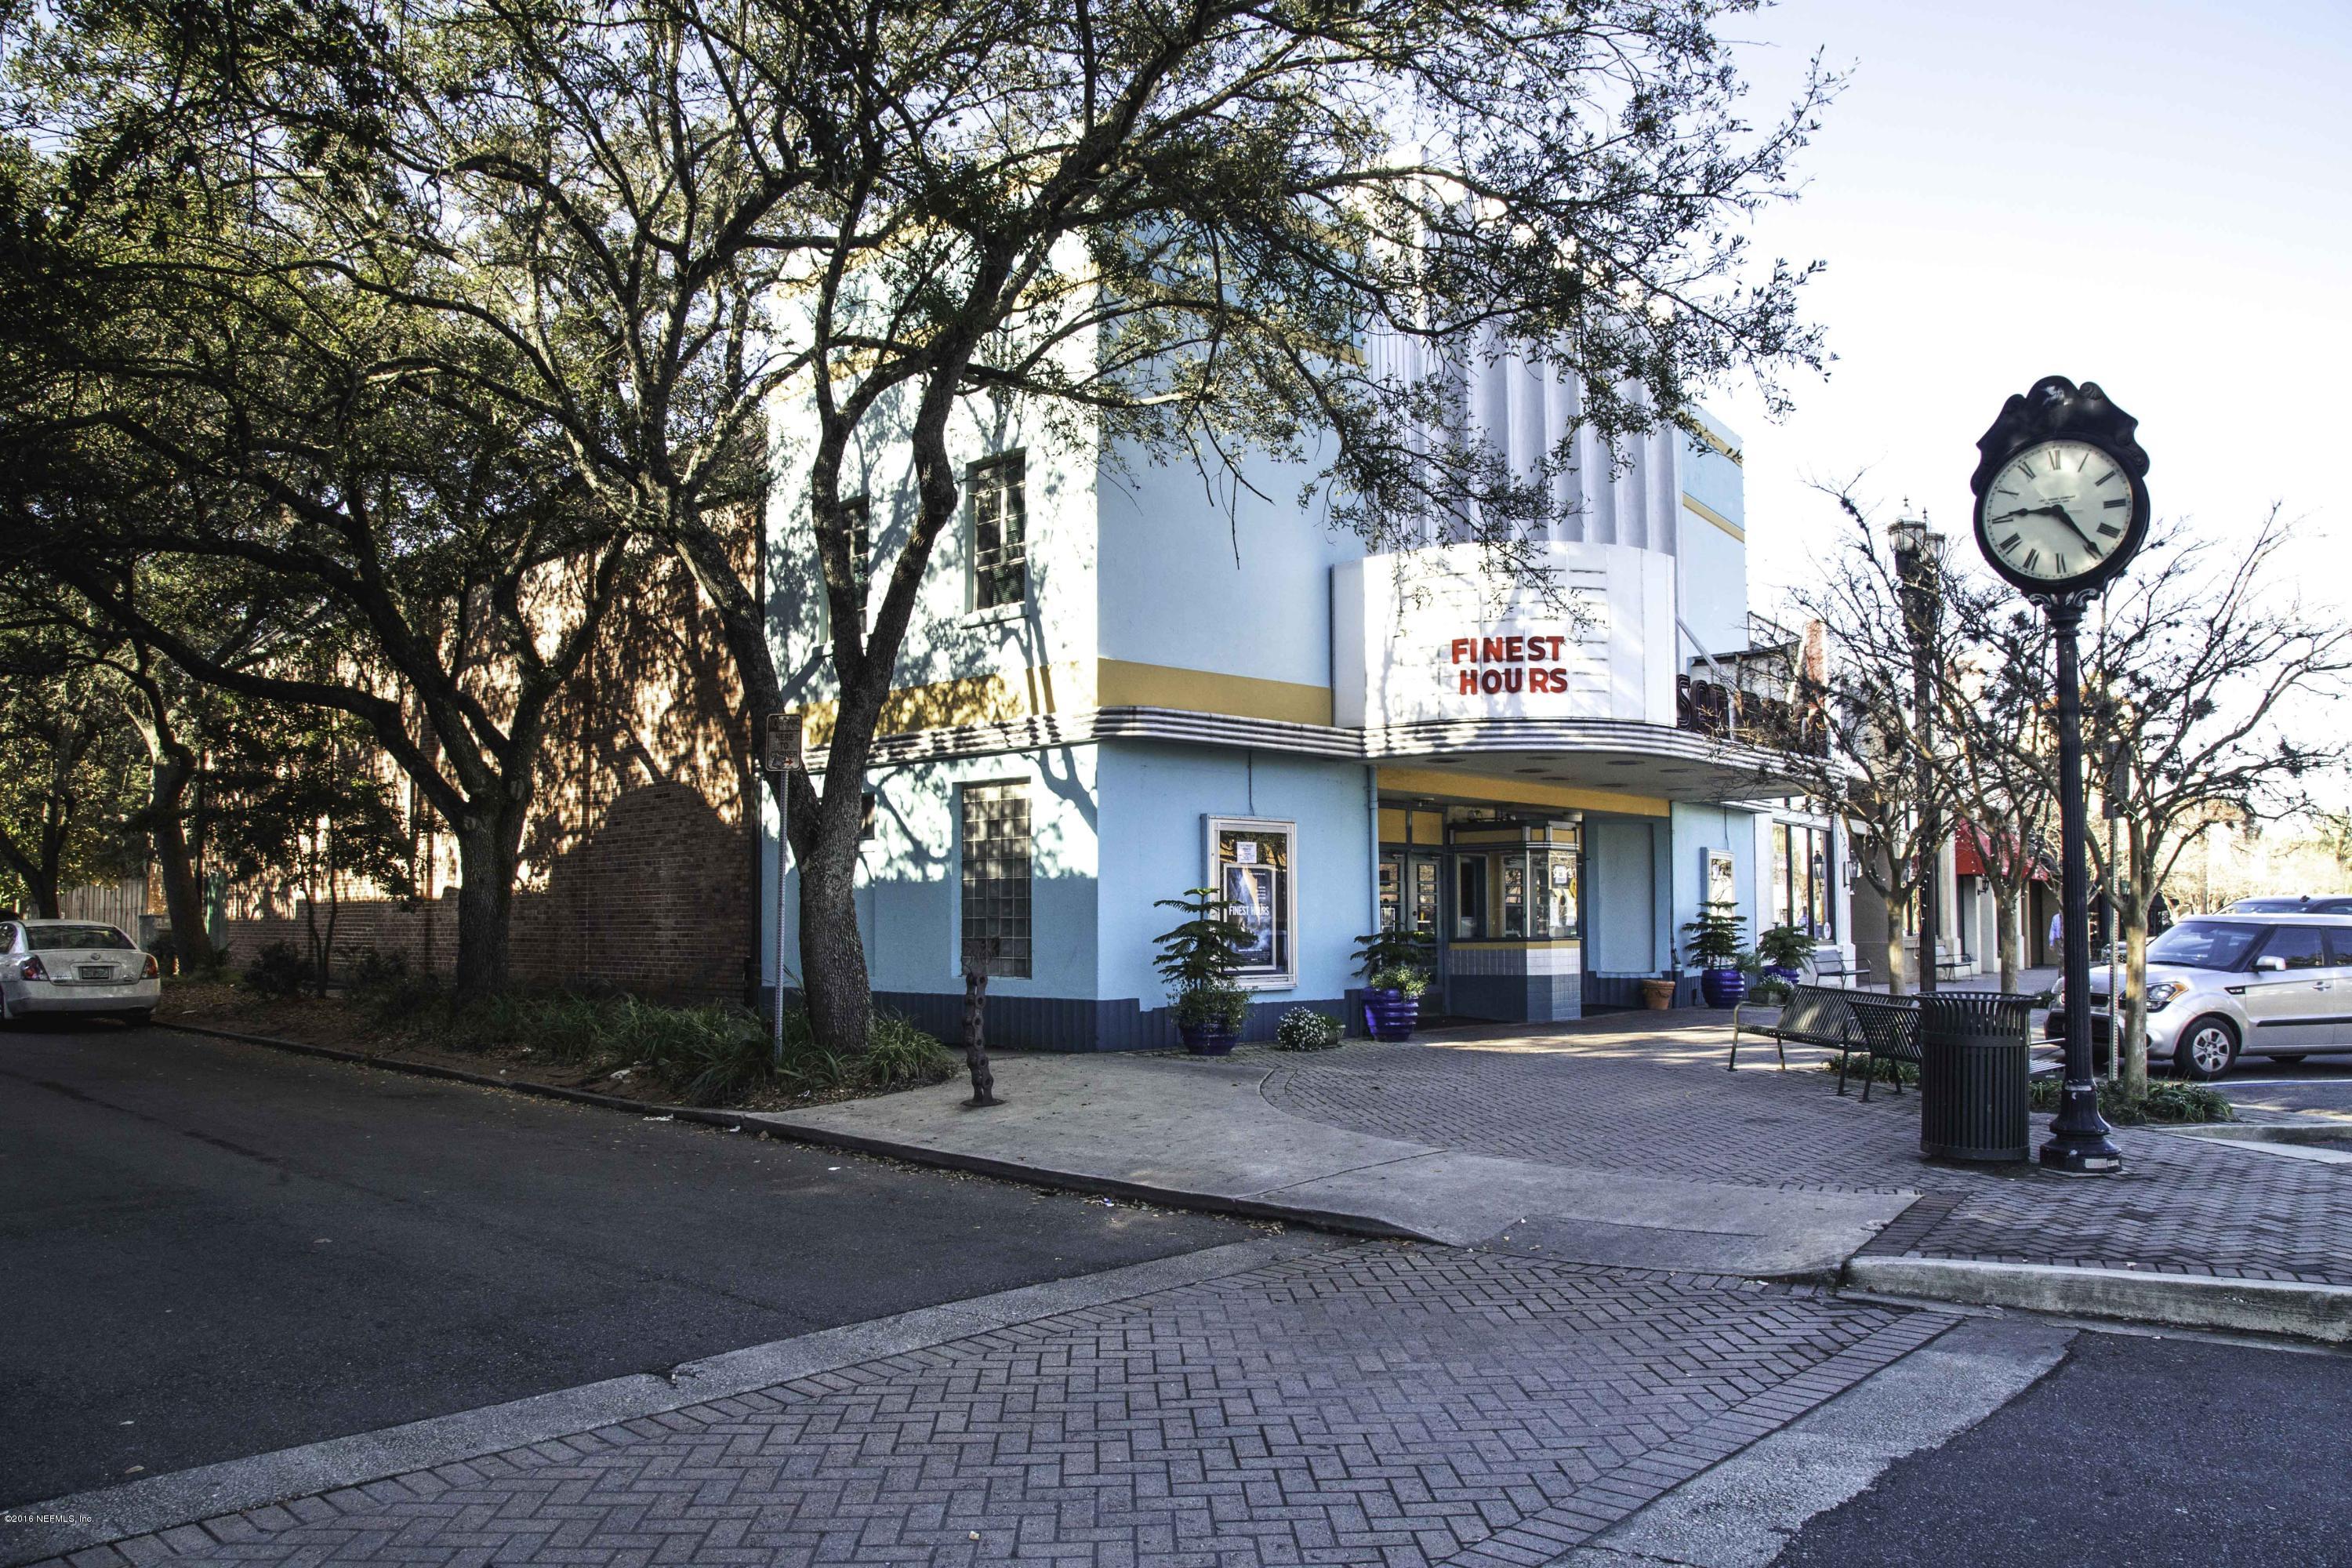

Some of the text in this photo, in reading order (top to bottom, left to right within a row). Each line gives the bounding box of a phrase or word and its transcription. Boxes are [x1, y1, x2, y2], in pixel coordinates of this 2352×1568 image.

[1451, 636, 1565, 664] FINEST
[1459, 667, 1568, 695] HOURS
[1229, 906, 1269, 916] FINEST HURS
